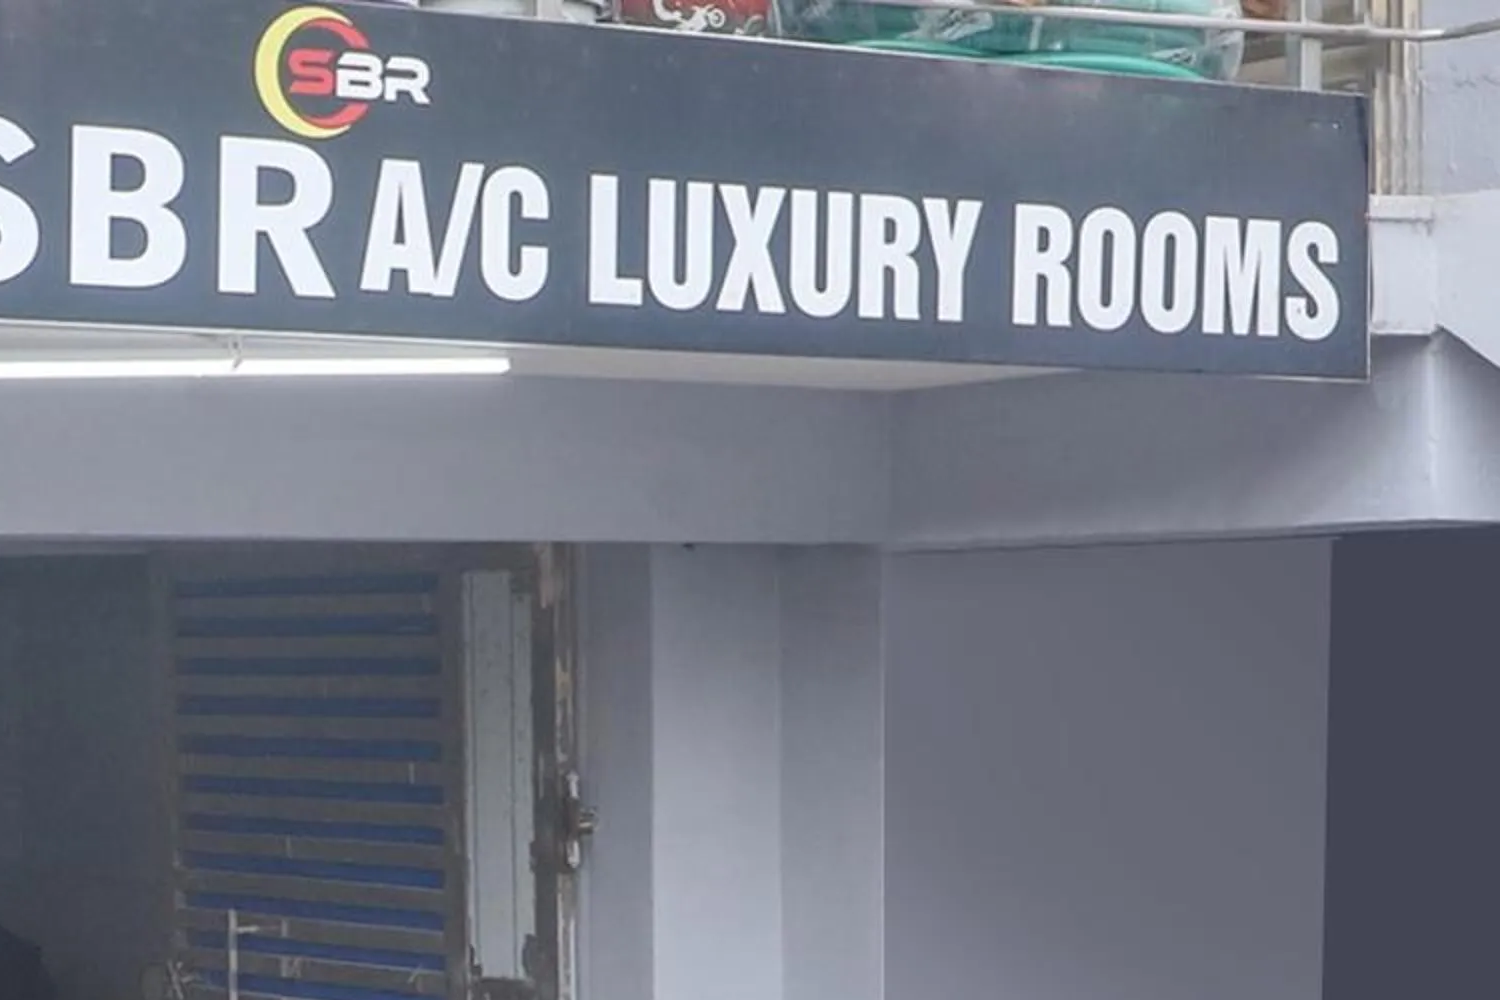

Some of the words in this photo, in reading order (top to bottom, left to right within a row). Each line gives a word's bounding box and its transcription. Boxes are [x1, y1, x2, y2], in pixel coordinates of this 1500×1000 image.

[288, 48, 431, 105] SBR
[359, 158, 550, 301] A/C
[589, 174, 984, 322] LUXURY
[1011, 203, 1340, 341] ROOMS
